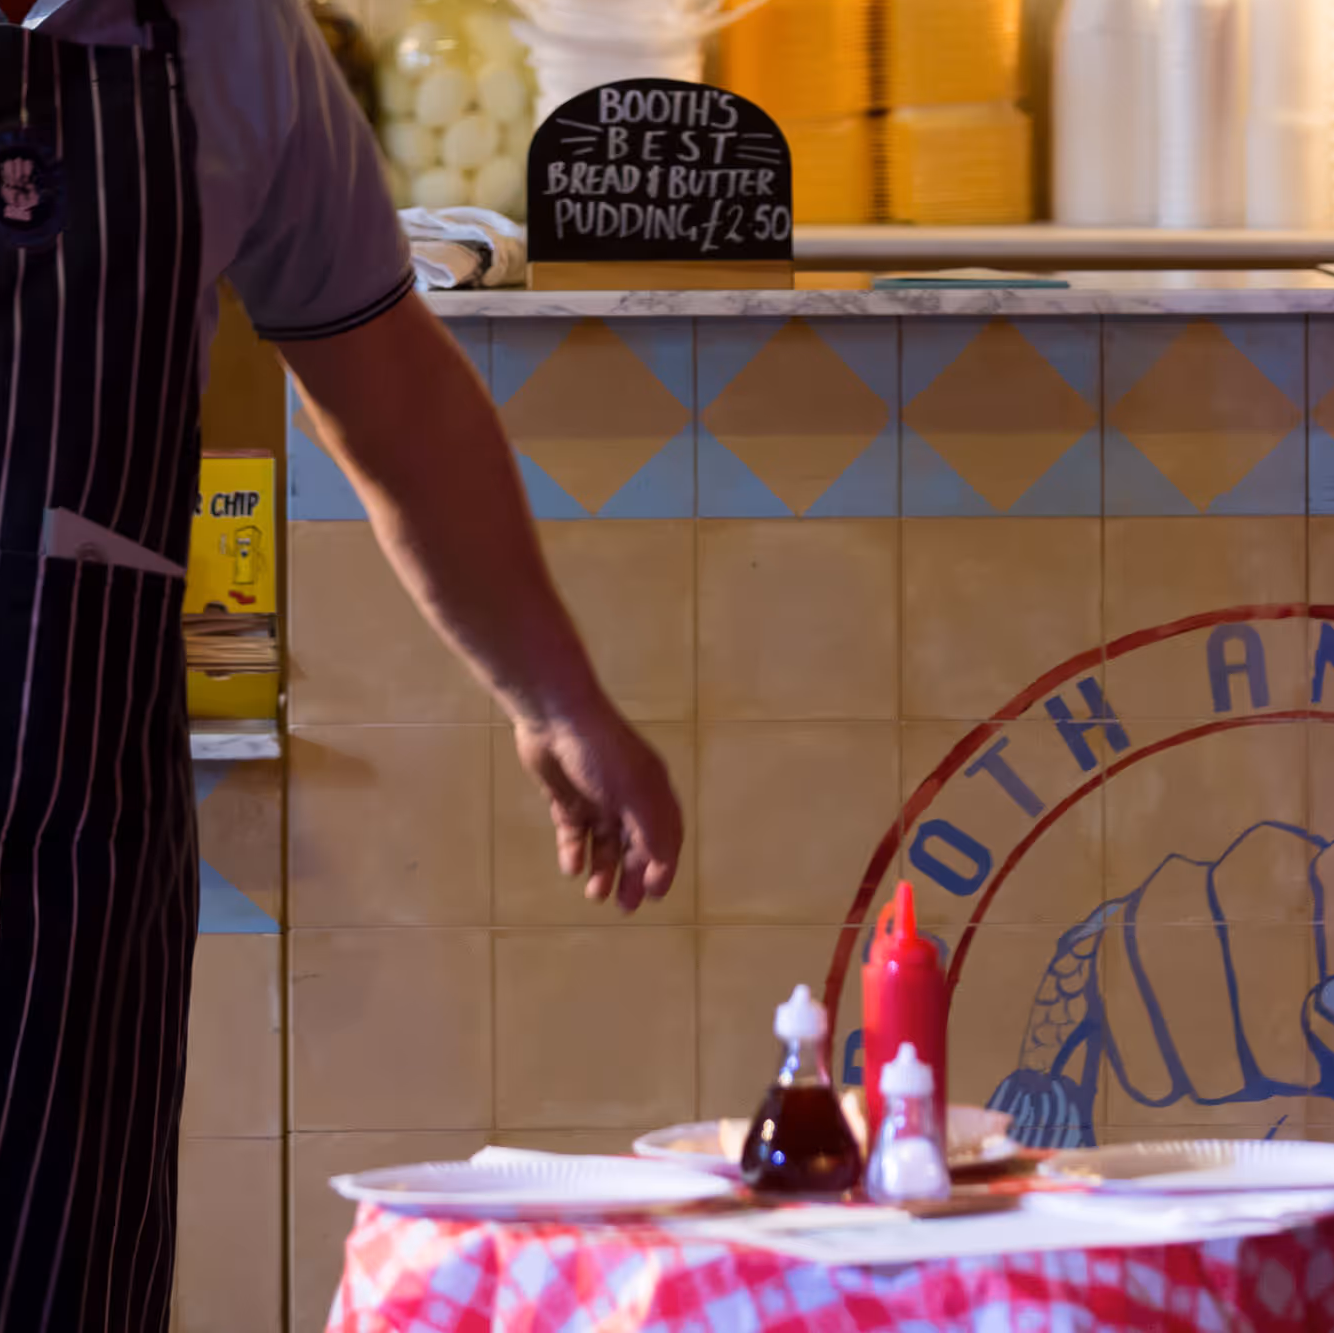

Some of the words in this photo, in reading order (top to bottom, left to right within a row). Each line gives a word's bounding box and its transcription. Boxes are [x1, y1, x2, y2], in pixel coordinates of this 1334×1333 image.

[599, 87, 739, 130] BOOTH'S
[608, 126, 738, 165] BEST
[542, 160, 640, 197] BREAD
[668, 165, 776, 200] BUTTER
[555, 197, 698, 242] PUDDING
[210, 490, 261, 518] CHIP
